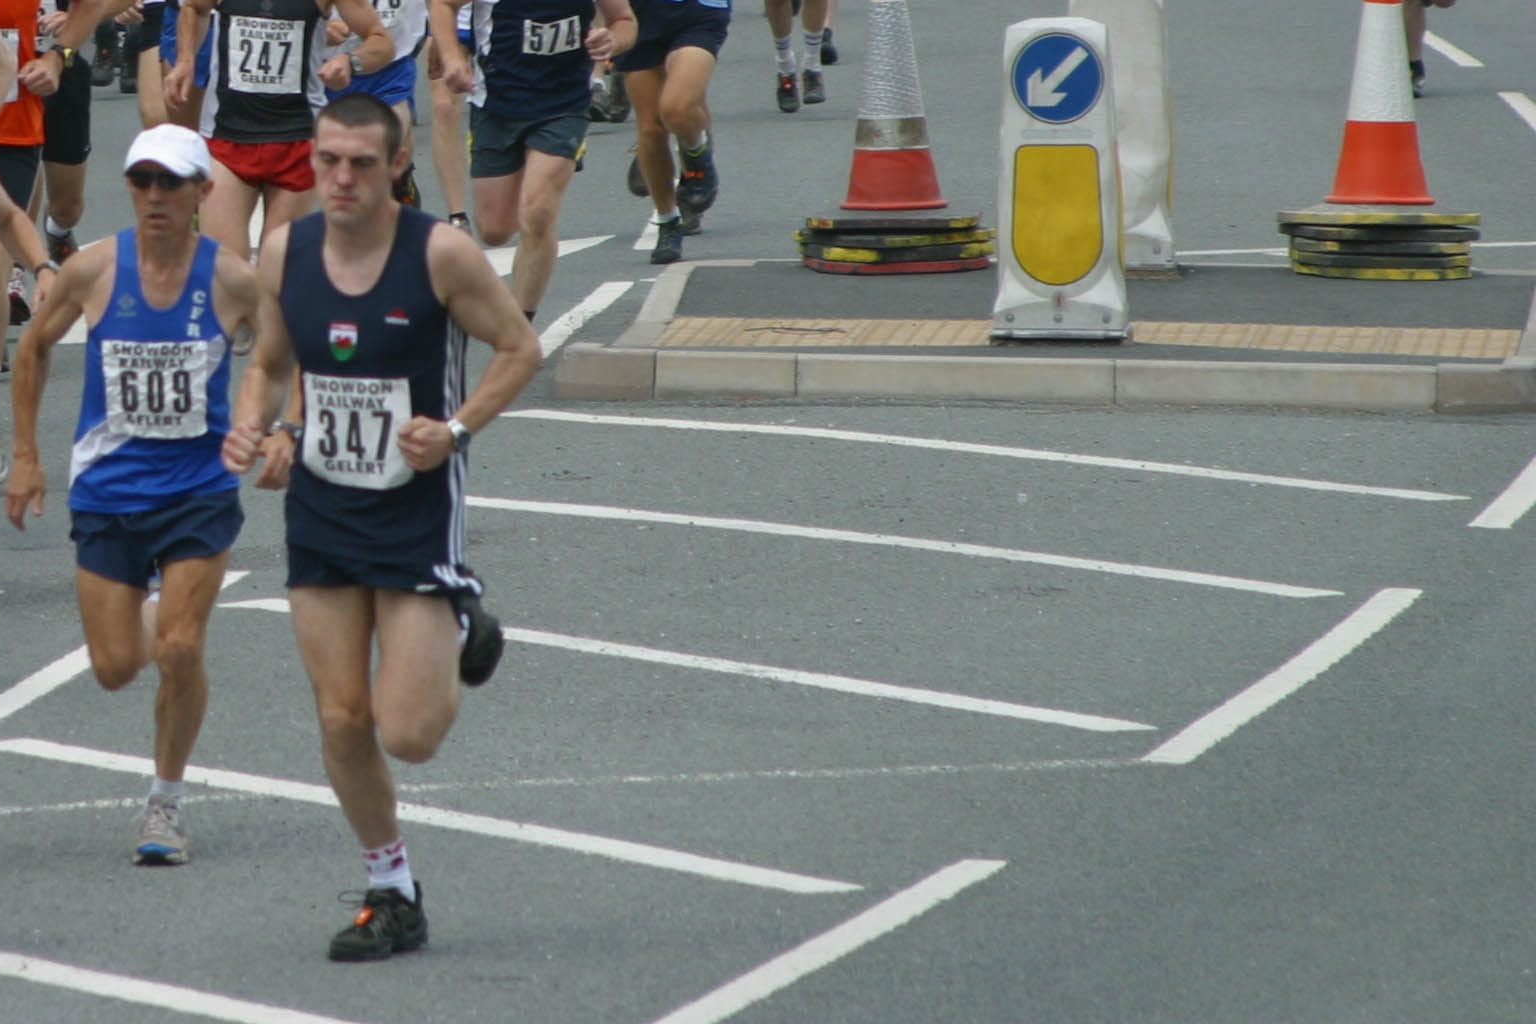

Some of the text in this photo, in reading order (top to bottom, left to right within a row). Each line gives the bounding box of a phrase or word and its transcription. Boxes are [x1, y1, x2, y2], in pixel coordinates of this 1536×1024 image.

[235, 18, 296, 30] SNOWDON
[240, 29, 290, 41] RAILWAY
[530, 19, 577, 54] 574
[239, 39, 292, 75] 247
[241, 74, 284, 85] GELERT
[112, 344, 193, 356] SNOWDON
[119, 357, 186, 369] RAILWAY
[120, 370, 192, 413] 609
[312, 378, 393, 394] SNOWDON
[317, 394, 387, 410] RAILWAY
[126, 414, 183, 426] GELERT
[318, 408, 393, 461] 347
[324, 460, 387, 475] GELERT
